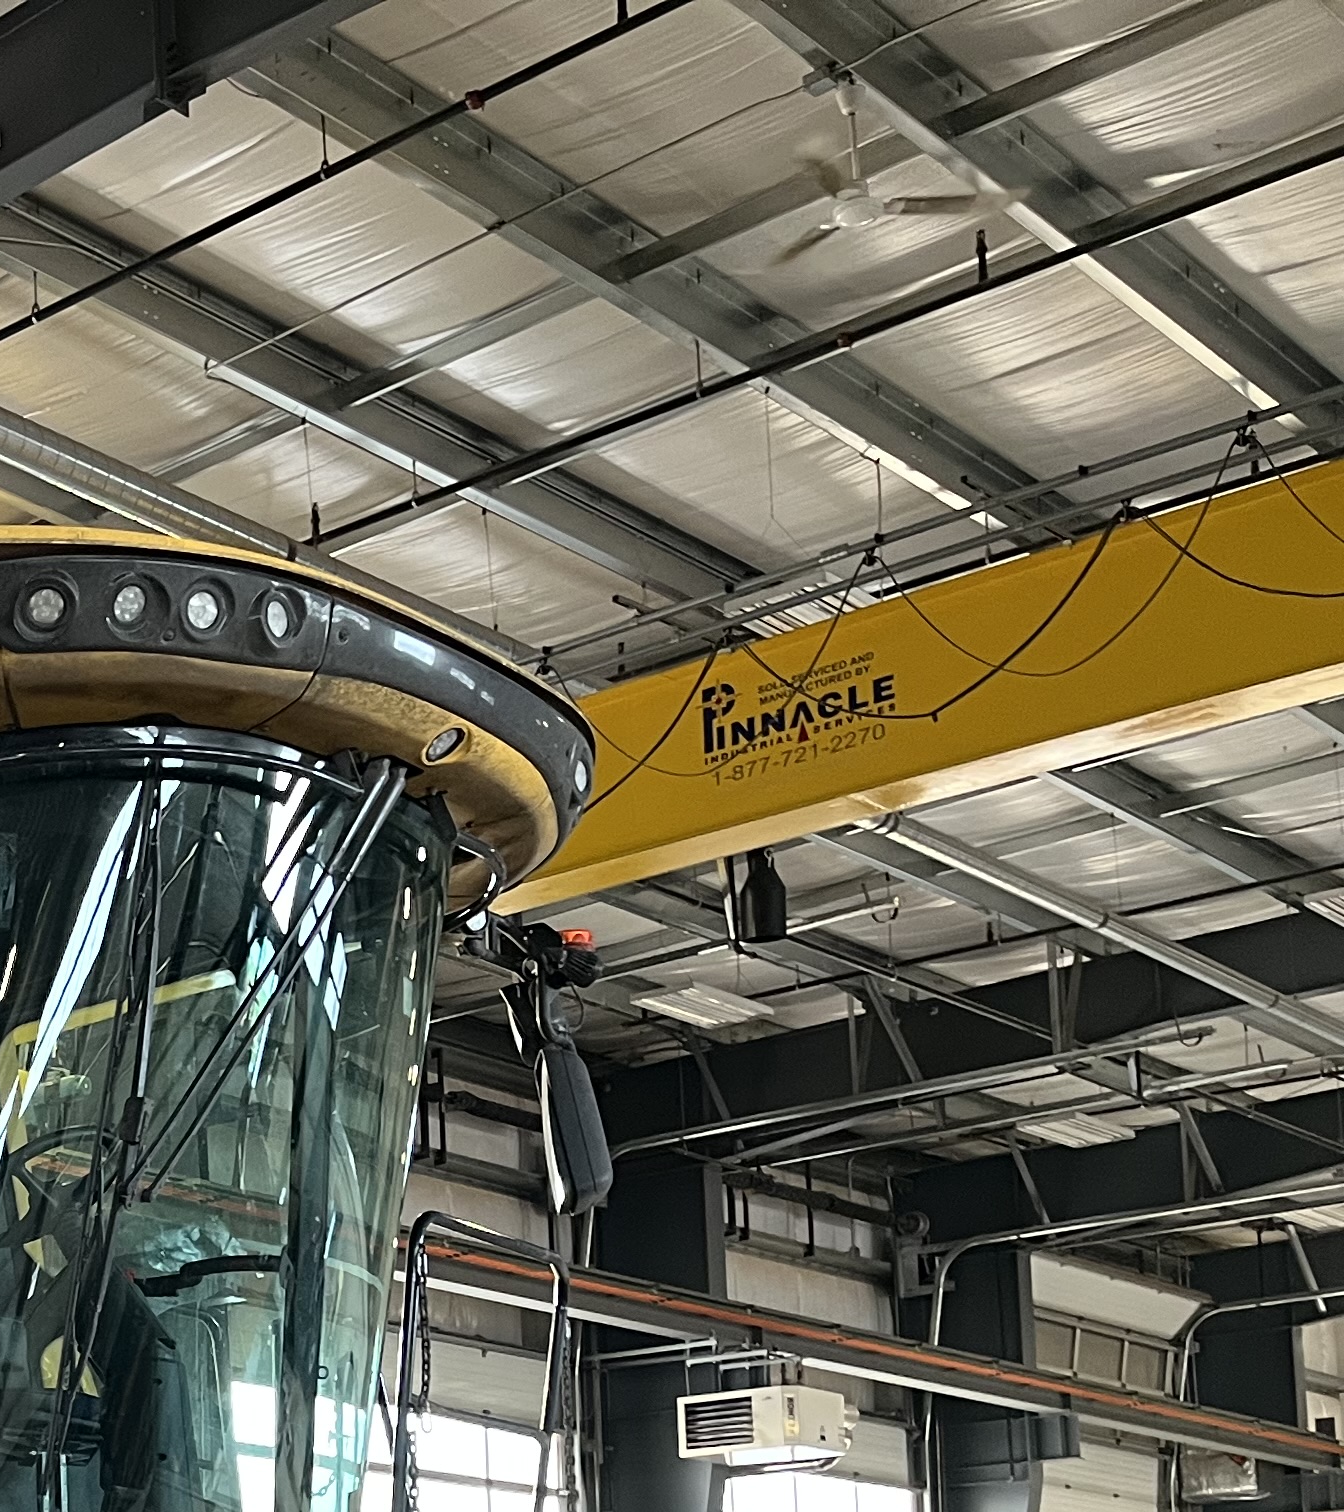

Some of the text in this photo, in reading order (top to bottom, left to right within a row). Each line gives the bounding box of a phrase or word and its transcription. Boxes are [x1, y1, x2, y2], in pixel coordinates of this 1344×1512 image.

[758, 664, 872, 706] MANUACTURED BY
[849, 651, 875, 666] AND
[700, 674, 897, 756] PINNACLE
[711, 722, 887, 787] 1-877-721-2270
